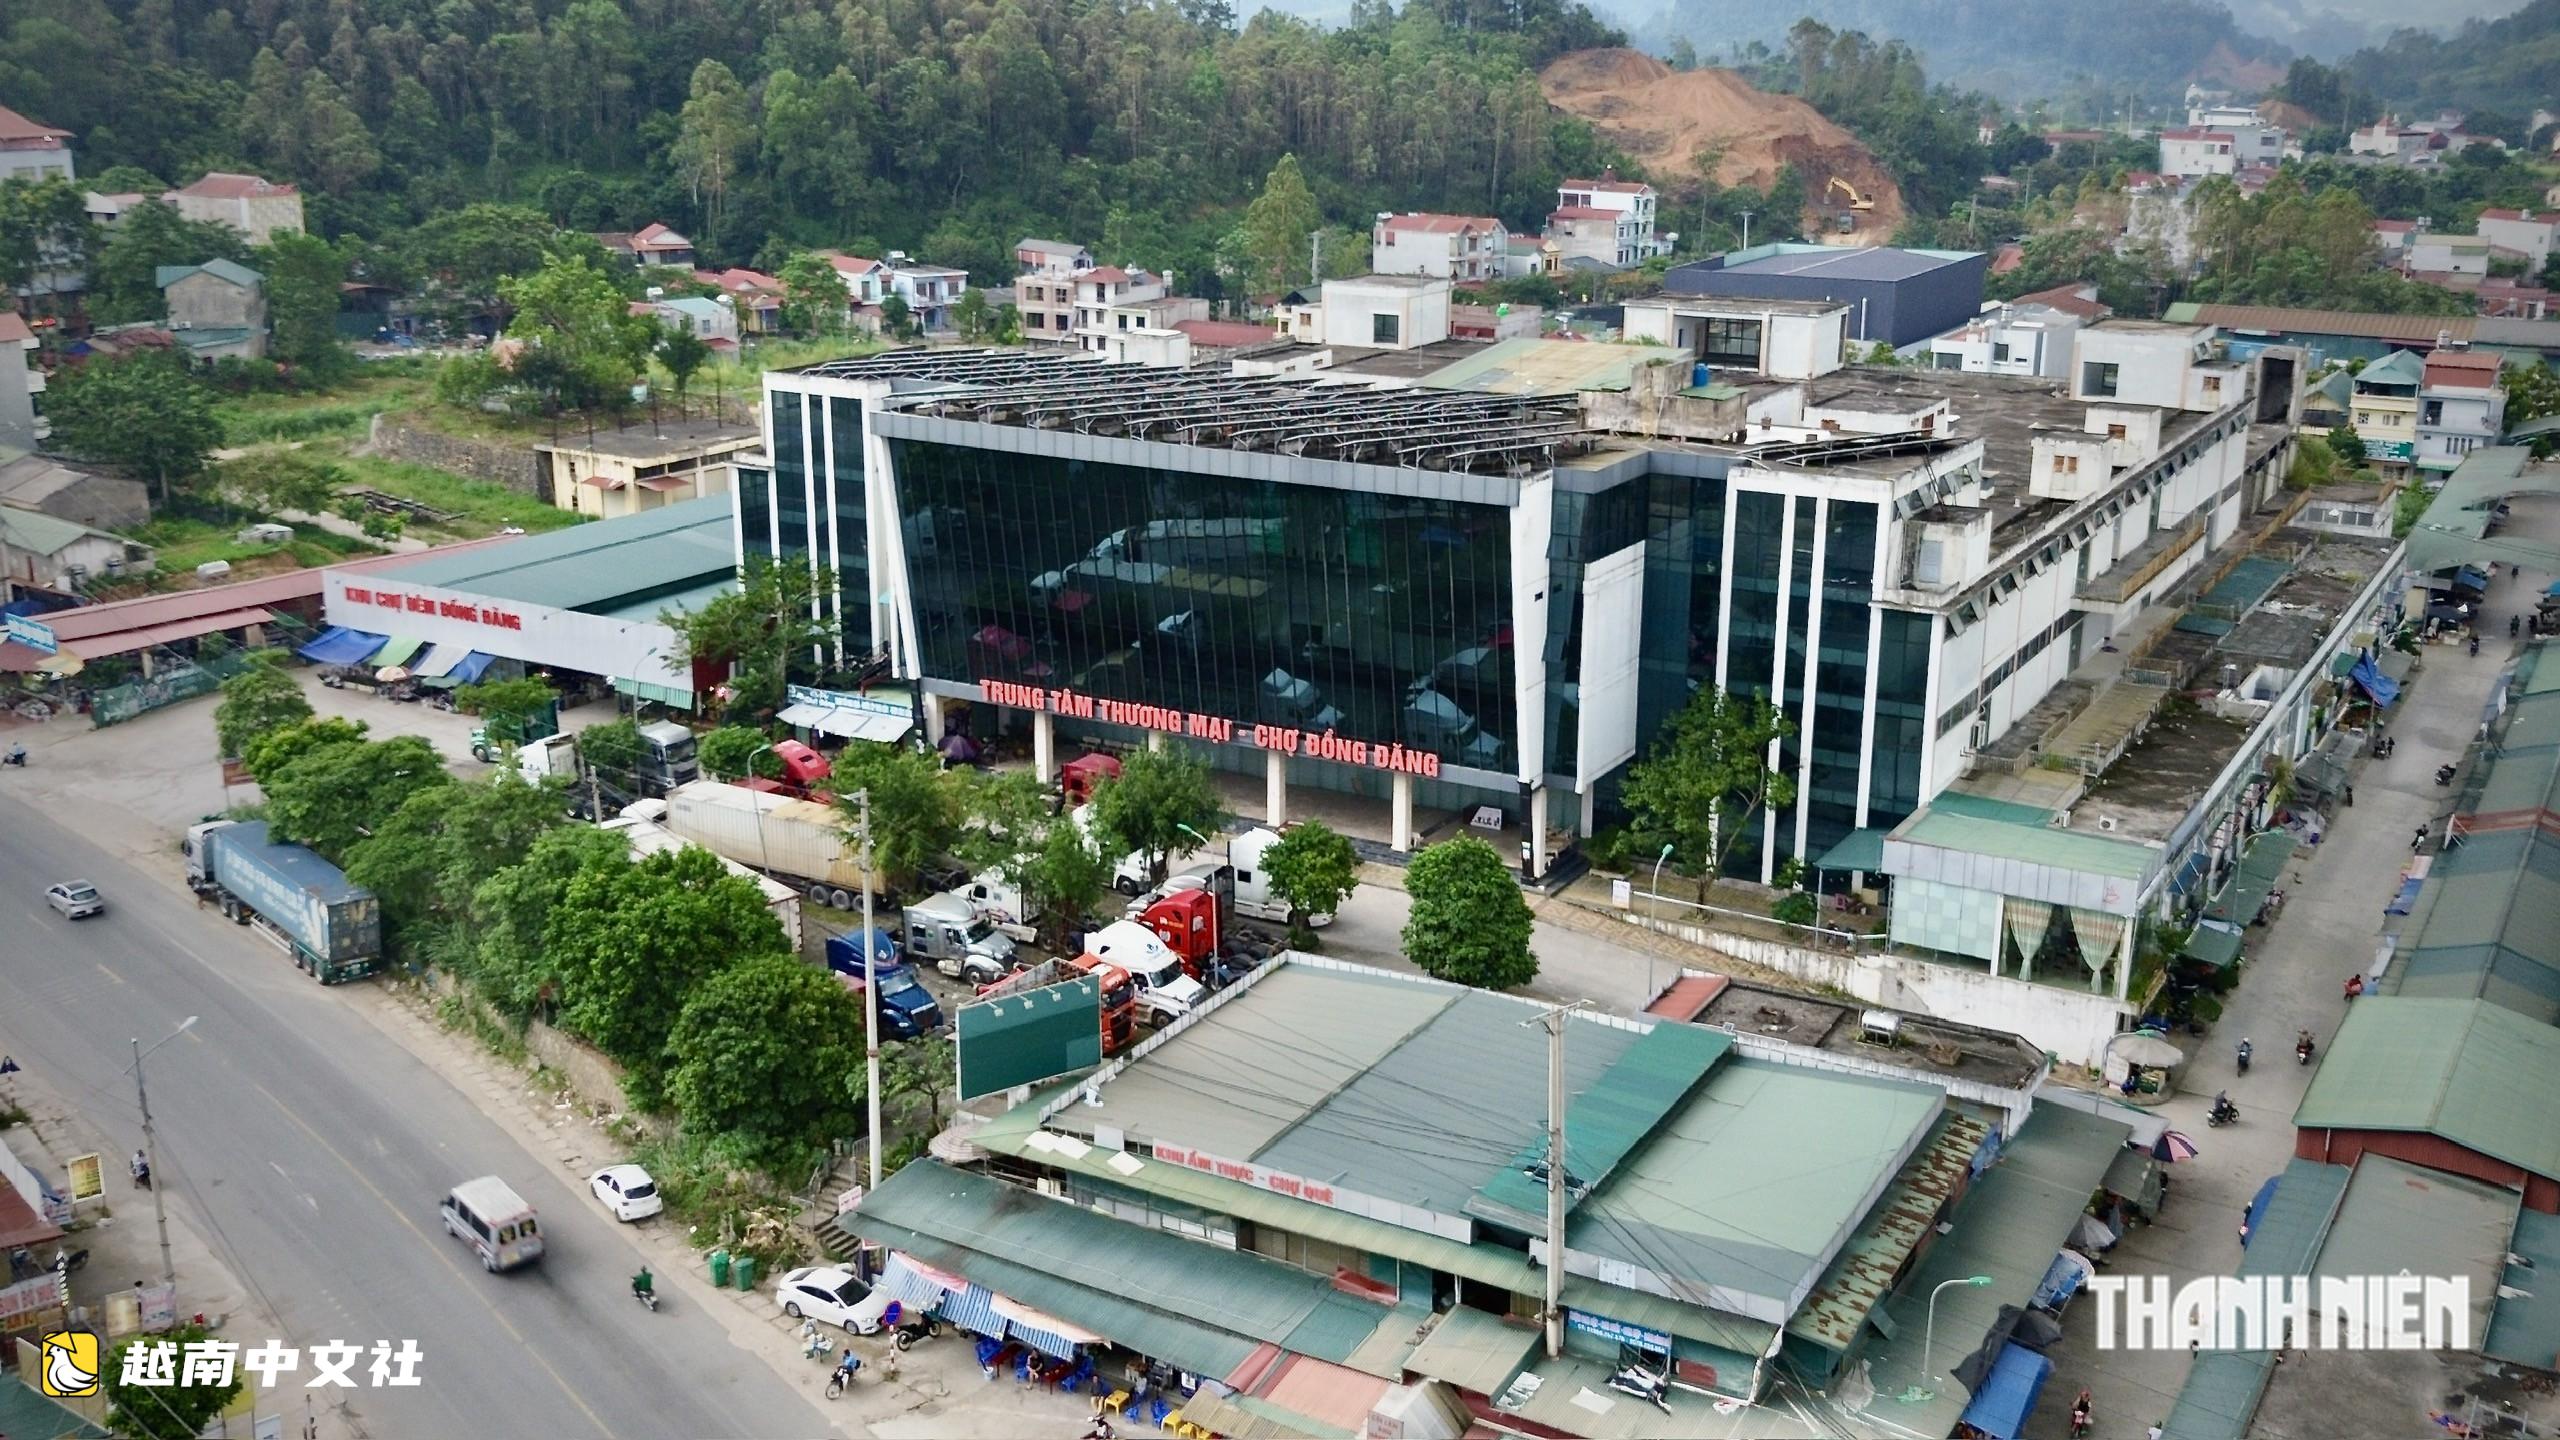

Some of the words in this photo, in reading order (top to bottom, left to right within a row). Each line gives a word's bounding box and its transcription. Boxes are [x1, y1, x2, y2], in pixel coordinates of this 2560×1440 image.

[979, 679, 1045, 711] TRUNG
[1051, 688, 1093, 719] TÂM
[1098, 698, 1183, 733] THƯƠNG
[1188, 713, 1232, 744] MẠI
[1254, 724, 1299, 757] CHỢ
[1304, 728, 1367, 765] ĐỒNG
[1373, 743, 1439, 777] ĐĂNG
[1155, 1145, 1185, 1164] KHU
